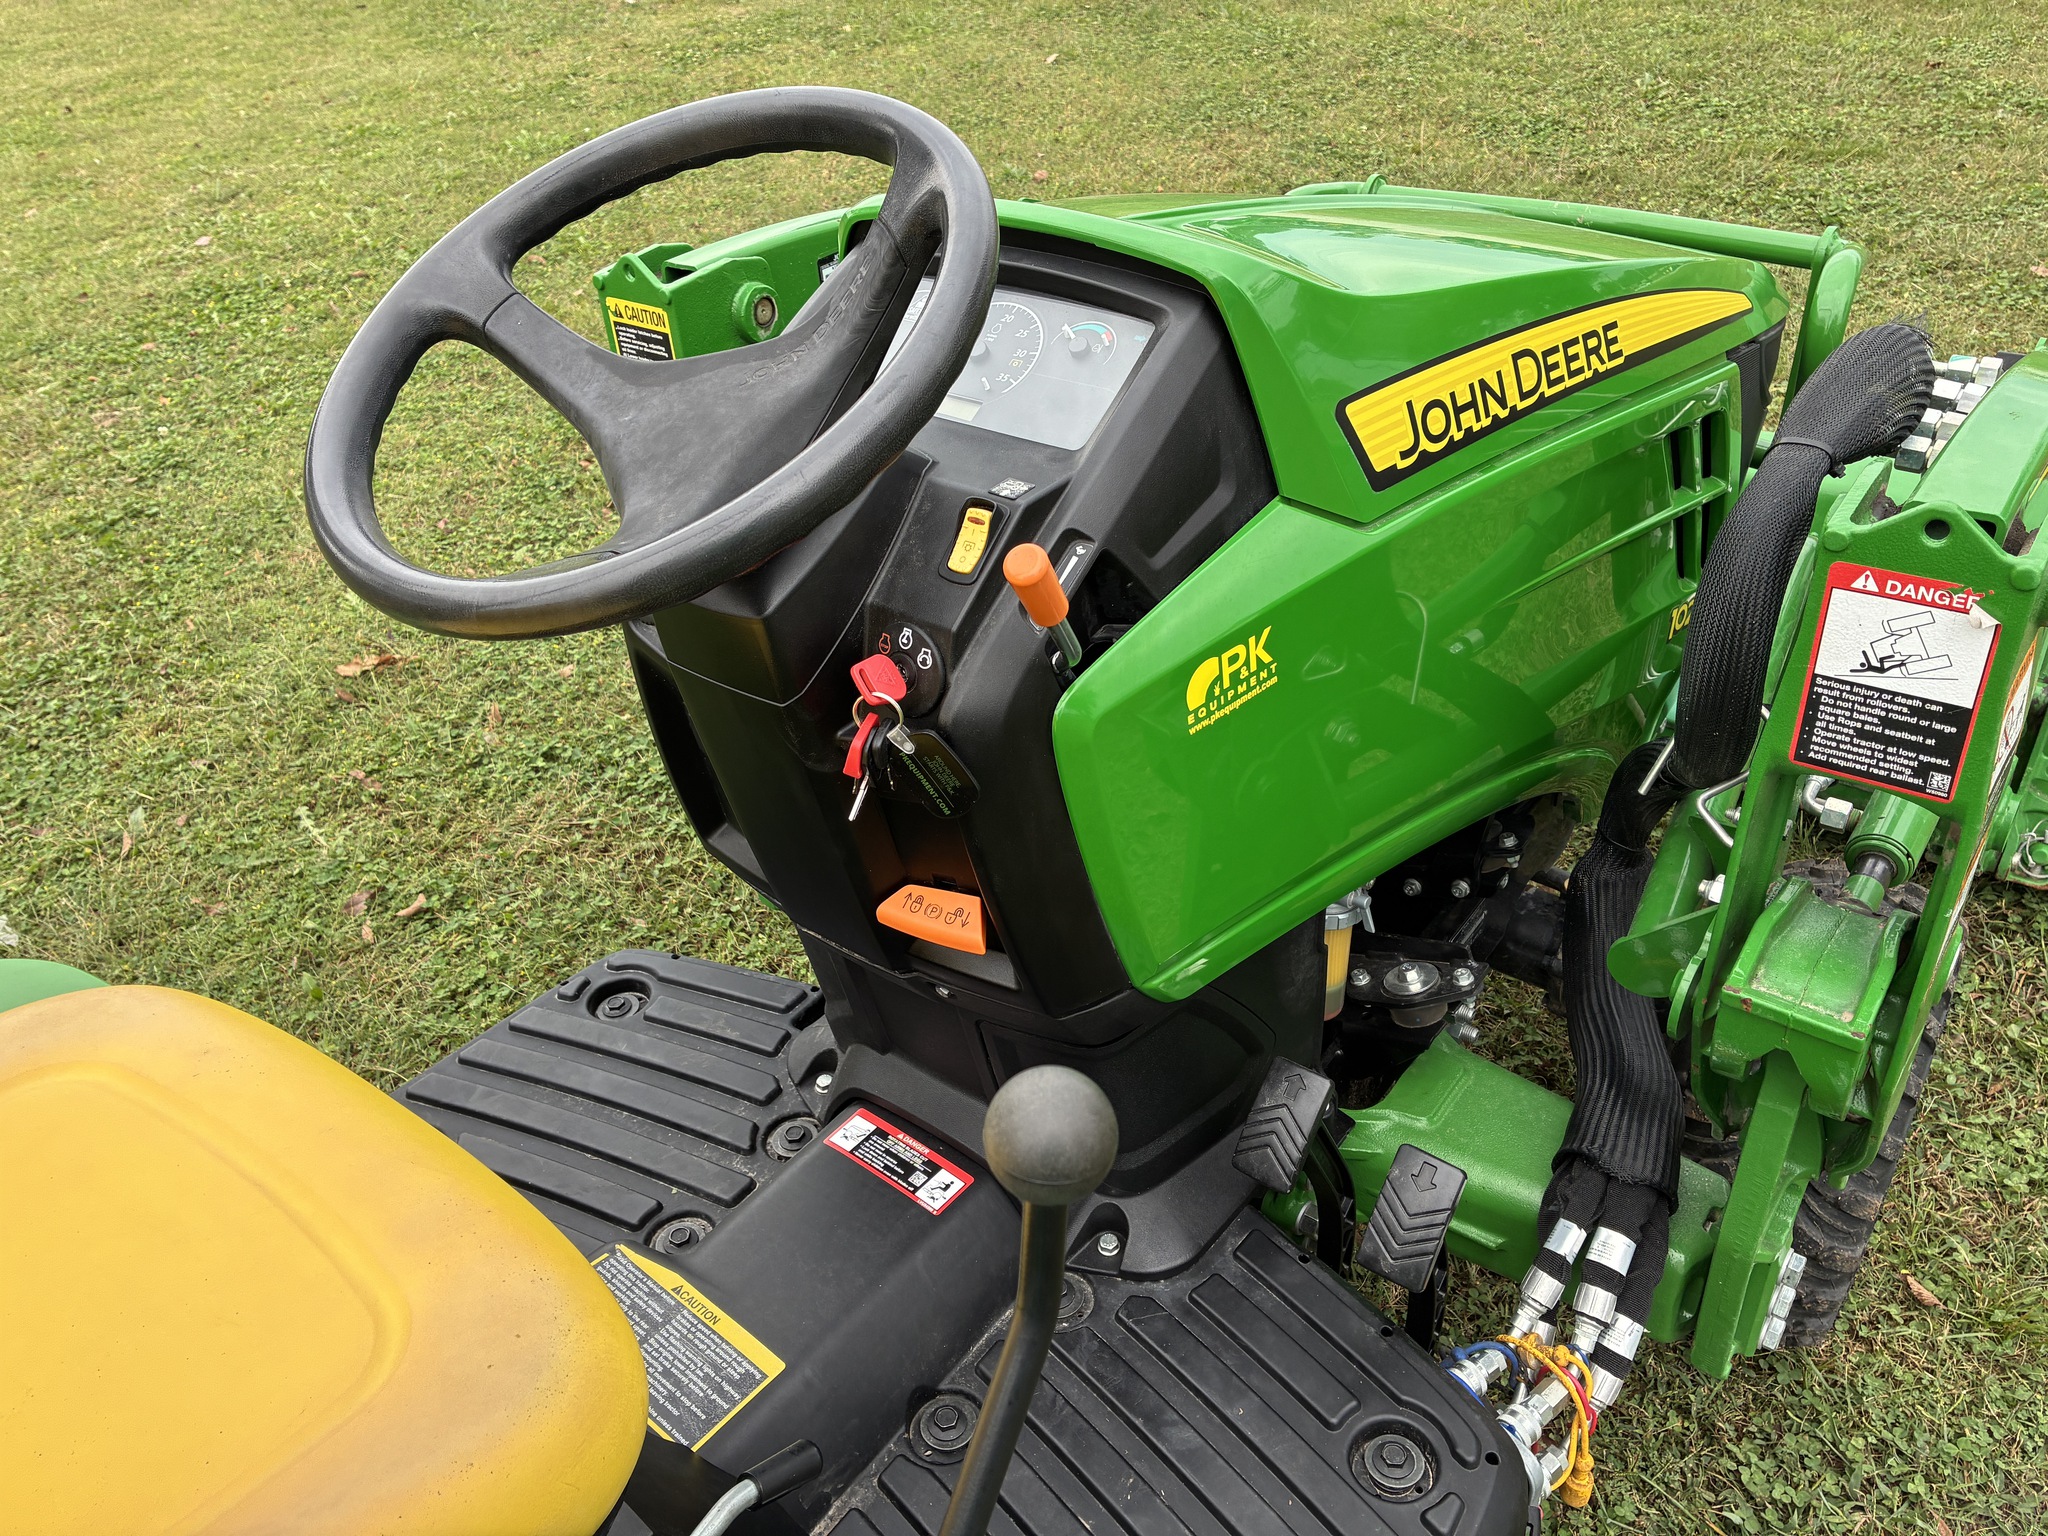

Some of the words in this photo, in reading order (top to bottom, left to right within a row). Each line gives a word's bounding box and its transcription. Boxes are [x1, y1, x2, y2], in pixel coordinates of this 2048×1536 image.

[625, 306, 666, 328] CAUTION
[739, 343, 810, 387] JOHN
[813, 253, 871, 344] DEERE
[1001, 314, 1014, 323] 20
[1015, 329, 1029, 338] 25
[1013, 349, 1027, 358] 30
[996, 374, 1010, 382] 35
[1399, 370, 1508, 461] JOHN
[1511, 321, 1624, 404] DEERE
[1188, 663, 1277, 725] EQUIPMENT
[1189, 676, 1278, 735] www.pkequipment.com
[1813, 685, 1840, 697] result
[1841, 691, 1864, 702] from
[1865, 697, 1911, 713] rollovers.
[1815, 677, 1851, 691] Serious
[1852, 685, 1880, 699] injury
[1881, 693, 1892, 701] or
[1894, 695, 1923, 707] death
[1924, 702, 1943, 712] can
[1815, 719, 1826, 728] all
[1828, 722, 1857, 735] times.
[1817, 711, 1835, 721] Use
[1836, 716, 1862, 729] Rops
[1863, 722, 1882, 733] and
[1883, 727, 1923, 742] seatbelt
[1924, 737, 1936, 745] at
[1818, 704, 1850, 717] square
[1852, 711, 1881, 724] bales.
[1820, 695, 1834, 704] Do
[1836, 699, 1852, 709] not
[1853, 703, 1886, 717] handle
[1887, 711, 1917, 724] round
[1918, 719, 1930, 727] or
[1931, 721, 1957, 734] large
[1809, 743, 1876, 765] recommended
[1878, 760, 1914, 776] setting.
[1811, 735, 1837, 747] Move
[1838, 742, 1872, 756] wheels
[1874, 751, 1884, 759] to
[1886, 753, 1918, 767] widest
[1813, 727, 1851, 743] Operate
[1852, 737, 1885, 750] tractor
[1886, 745, 1897, 753] at
[1898, 748, 1917, 758] low
[1918, 752, 1951, 768] speed.
[899, 752, 951, 815] PKEQUIPMENT.COM
[1807, 750, 1827, 761] Add
[1828, 756, 1867, 772] required
[1869, 767, 1888, 777] rear
[1890, 771, 1925, 786] ballast.
[903, 1136, 930, 1155] DANGER
[679, 1288, 721, 1326] CAUTION
[646, 1404, 659, 1417] hine
